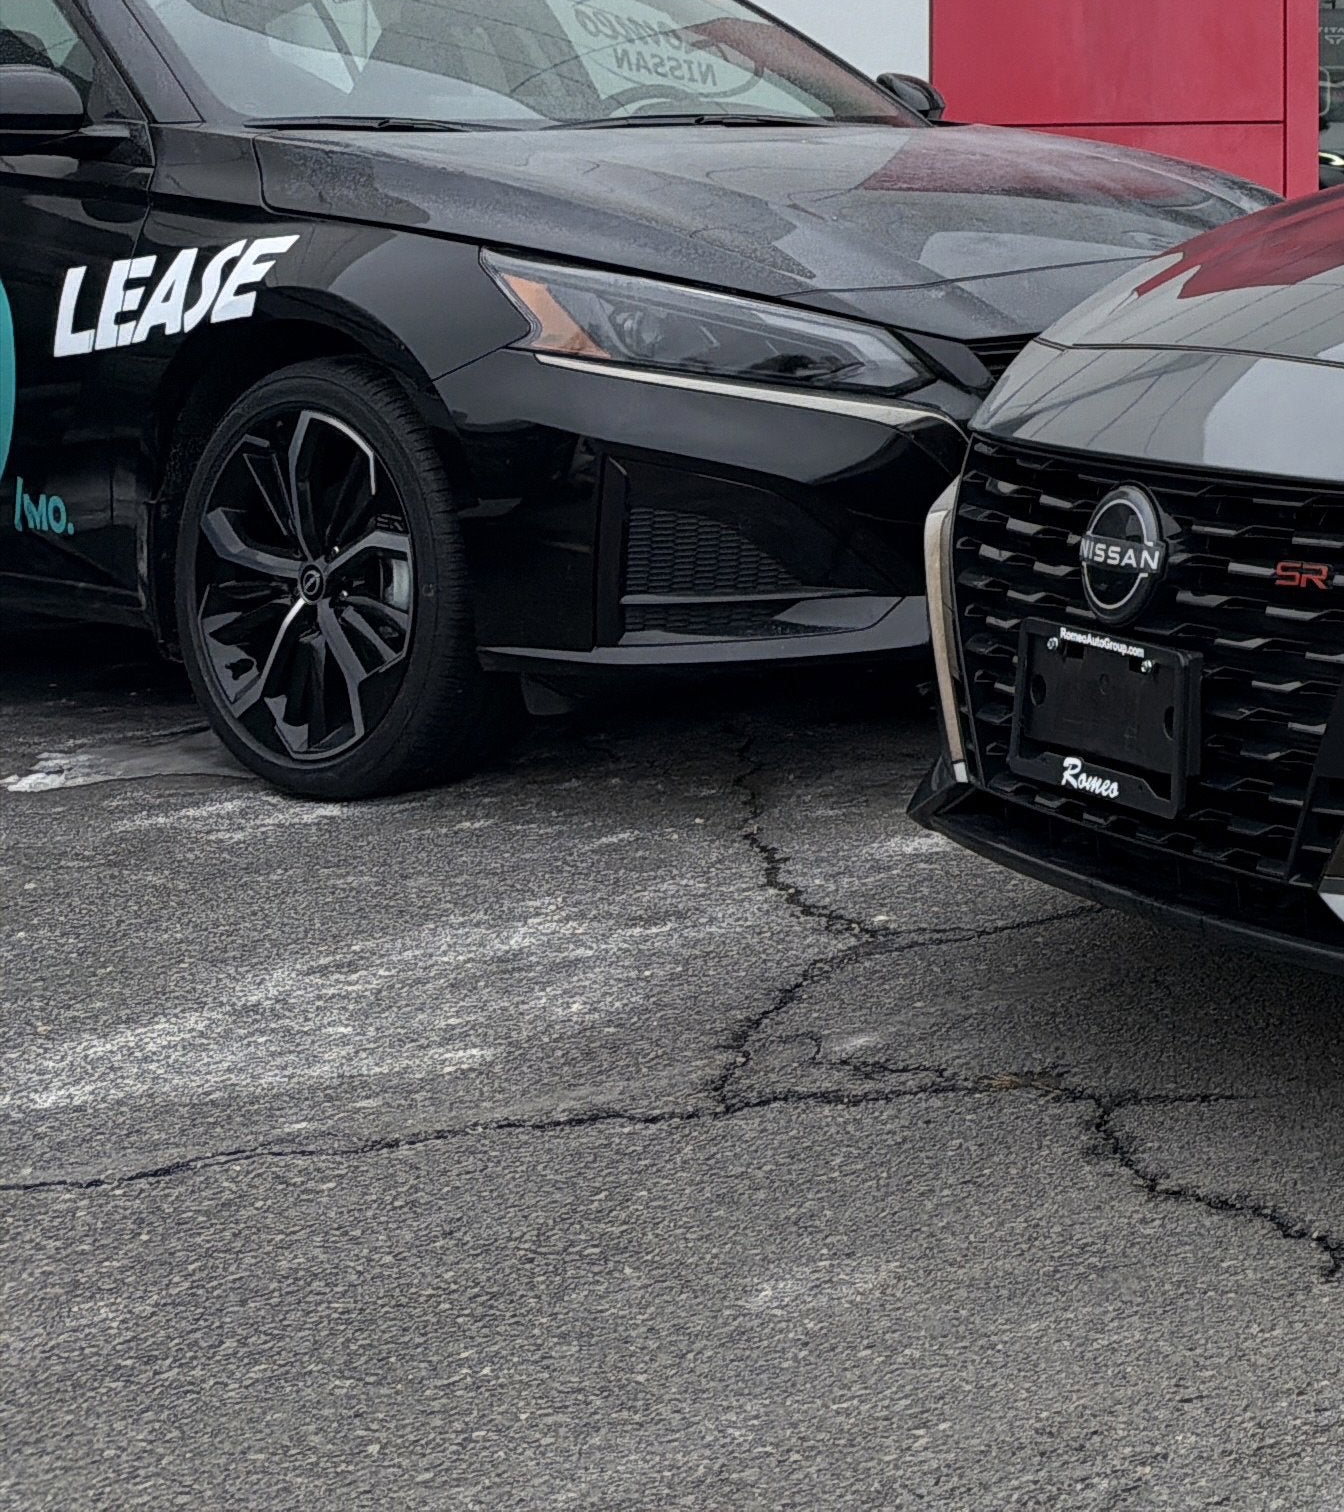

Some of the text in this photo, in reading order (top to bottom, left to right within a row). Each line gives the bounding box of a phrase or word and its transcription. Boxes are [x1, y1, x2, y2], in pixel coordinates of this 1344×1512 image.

[53, 235, 301, 358] LEASE
[14, 475, 75, 536] /MO.
[1079, 537, 1160, 570] NISSAN
[1275, 561, 1330, 590] SR
[1060, 626, 1145, 658] RomeoAutoGroup.com
[1061, 756, 1120, 799] Romeo
